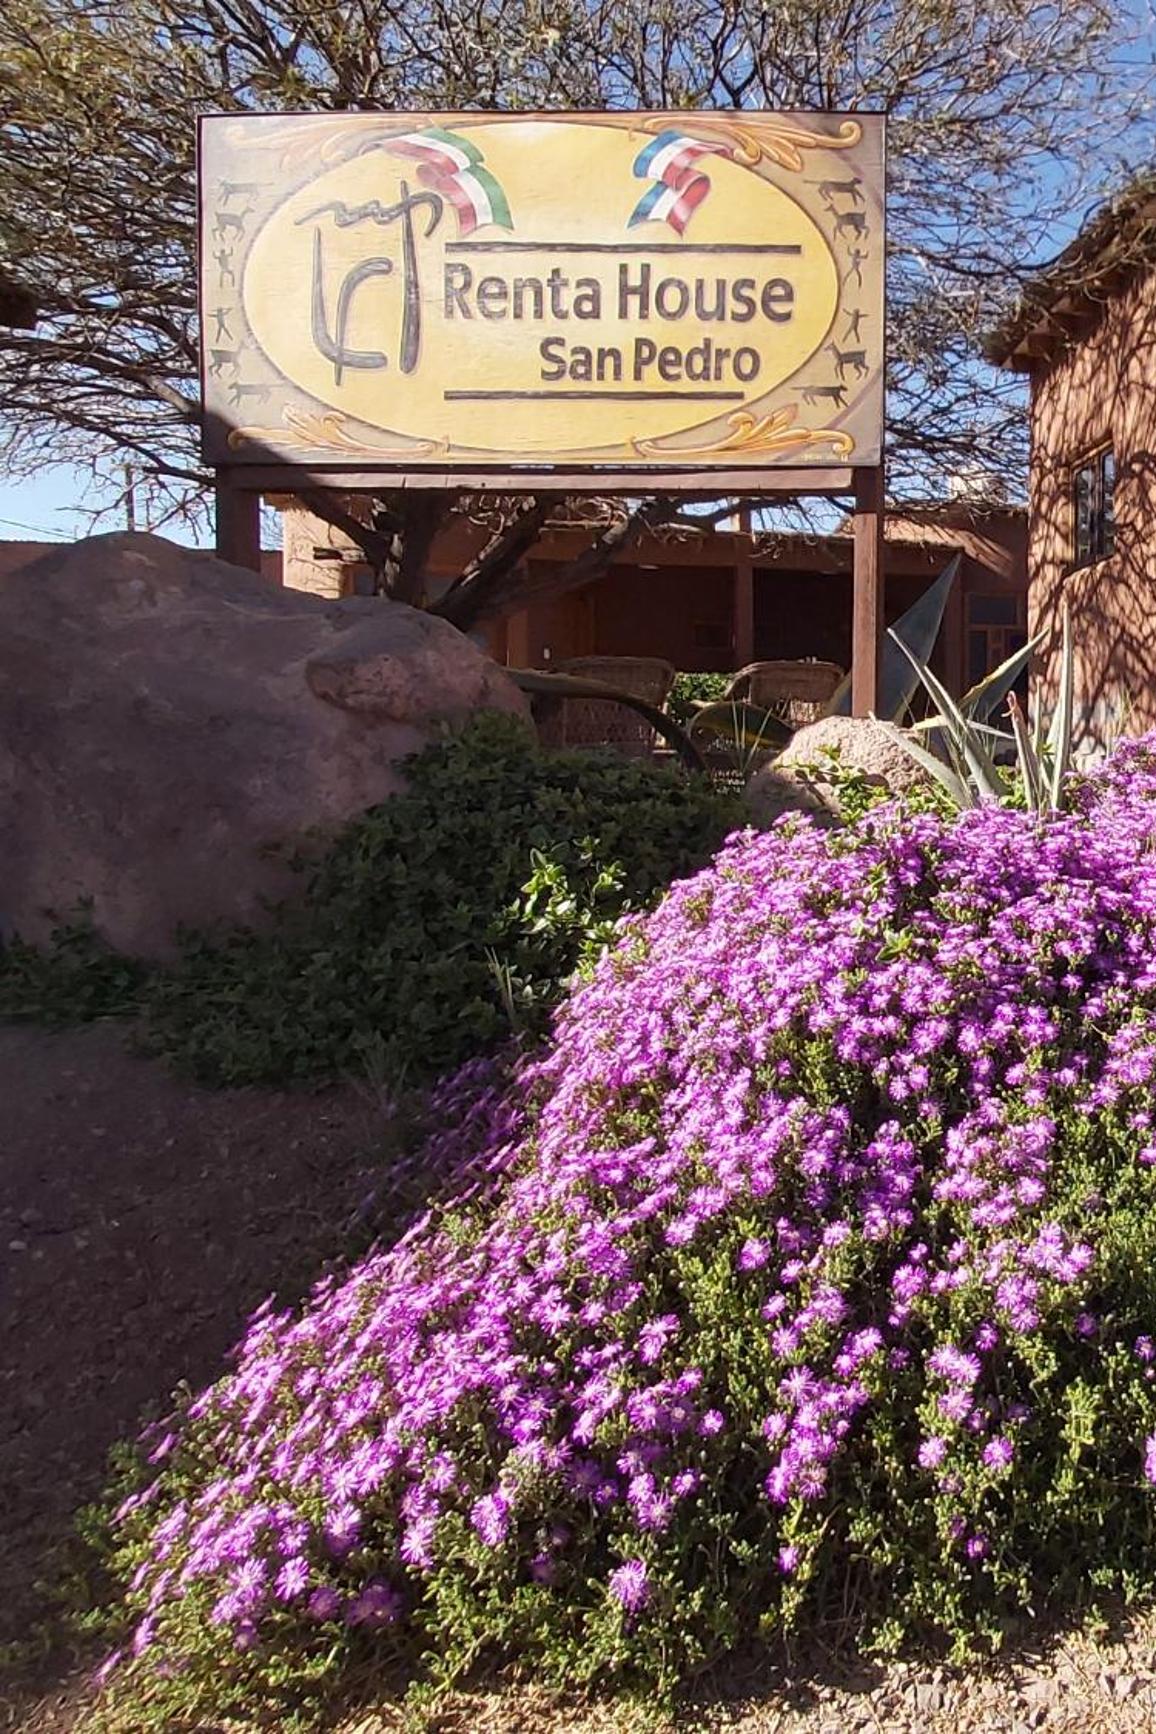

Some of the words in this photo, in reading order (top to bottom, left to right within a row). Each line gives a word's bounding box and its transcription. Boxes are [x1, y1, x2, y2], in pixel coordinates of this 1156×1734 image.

[443, 262, 602, 320] Renta
[618, 262, 795, 323] House
[539, 336, 623, 382] San
[633, 337, 761, 382] Pedro
